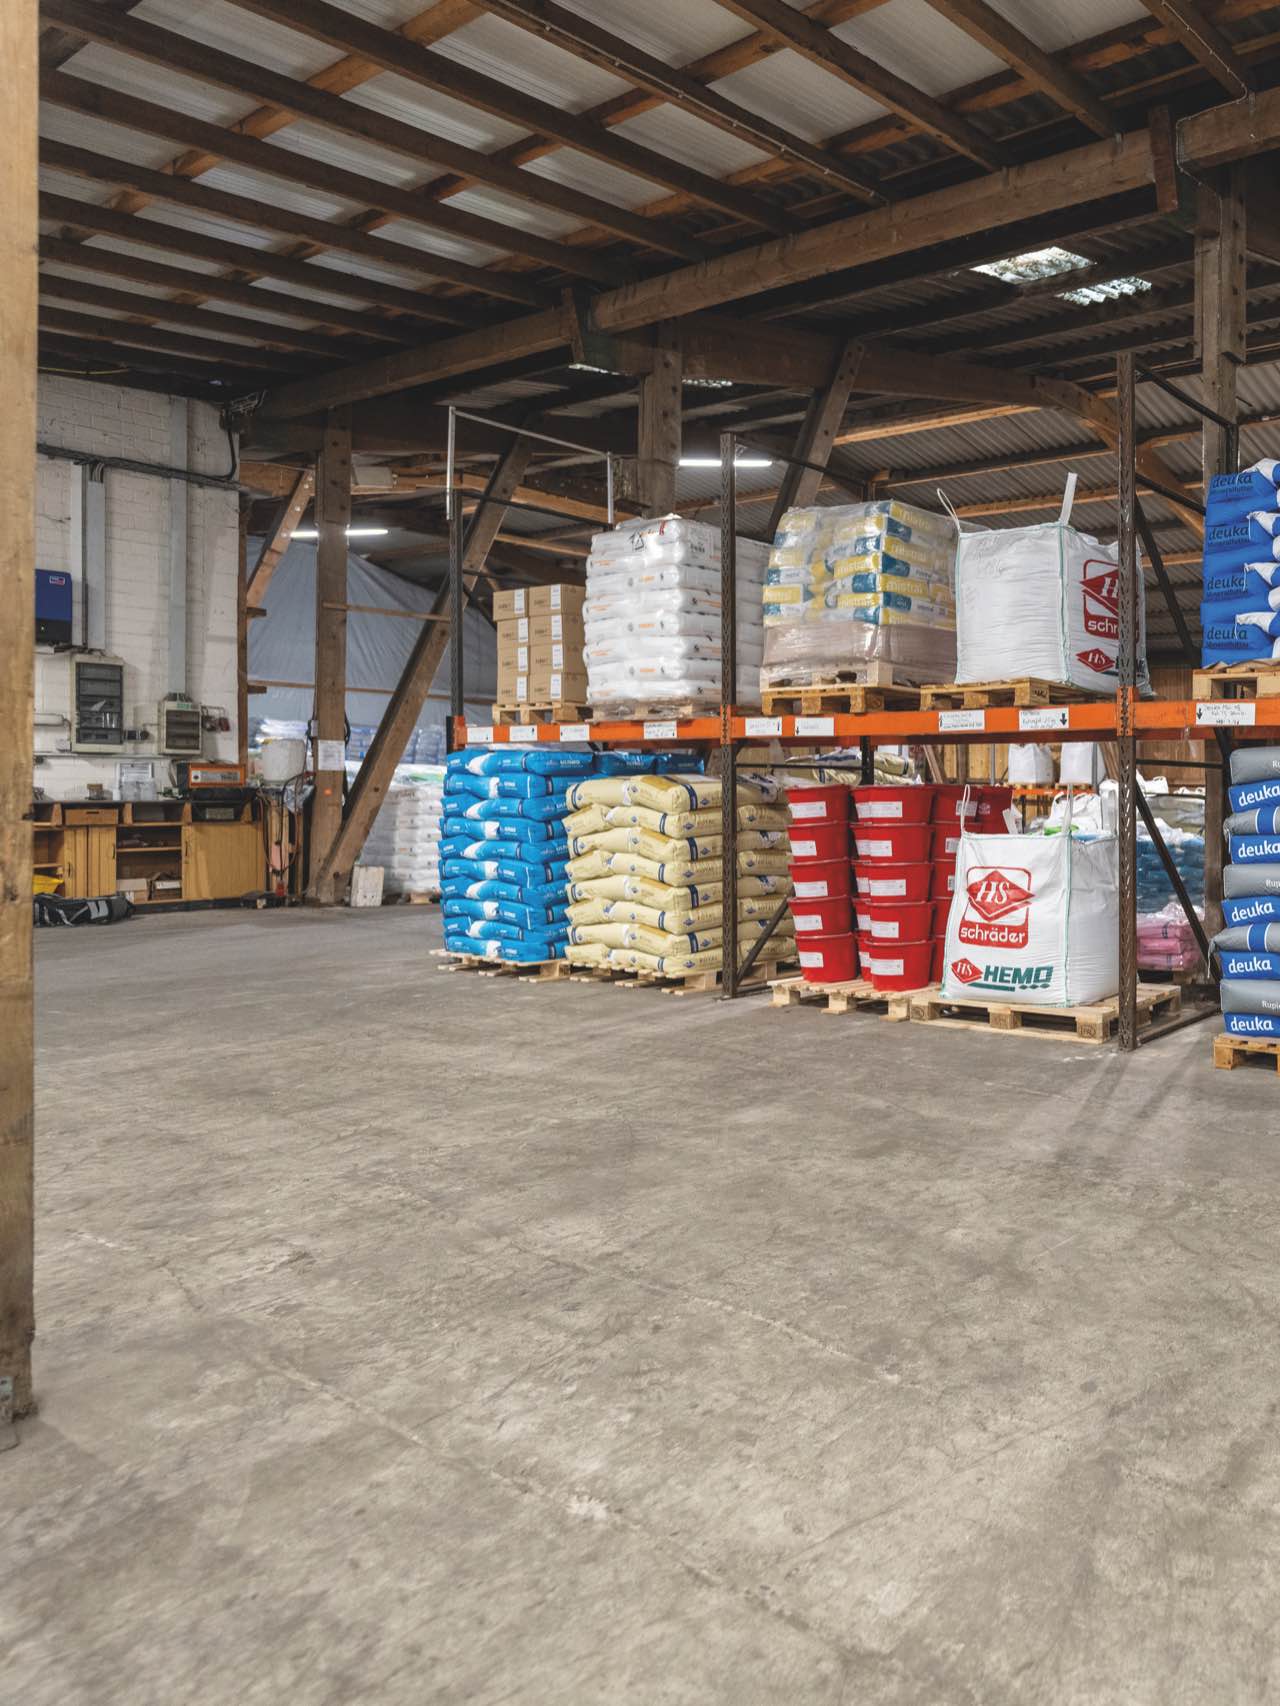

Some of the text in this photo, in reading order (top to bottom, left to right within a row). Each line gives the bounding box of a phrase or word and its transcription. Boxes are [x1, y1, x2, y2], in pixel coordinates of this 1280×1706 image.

[1213, 473, 1252, 488] deuka
[1209, 525, 1250, 541] deuka
[1207, 626, 1248, 640] deuka
[1088, 652, 1106, 665] HS
[975, 880, 1010, 904] HS
[1231, 902, 1274, 923] deuka
[961, 924, 1025, 944] schräder
[956, 962, 1054, 984] HS HEMO
[1228, 956, 1273, 974] deuka
[1230, 1017, 1274, 1031] deuka
